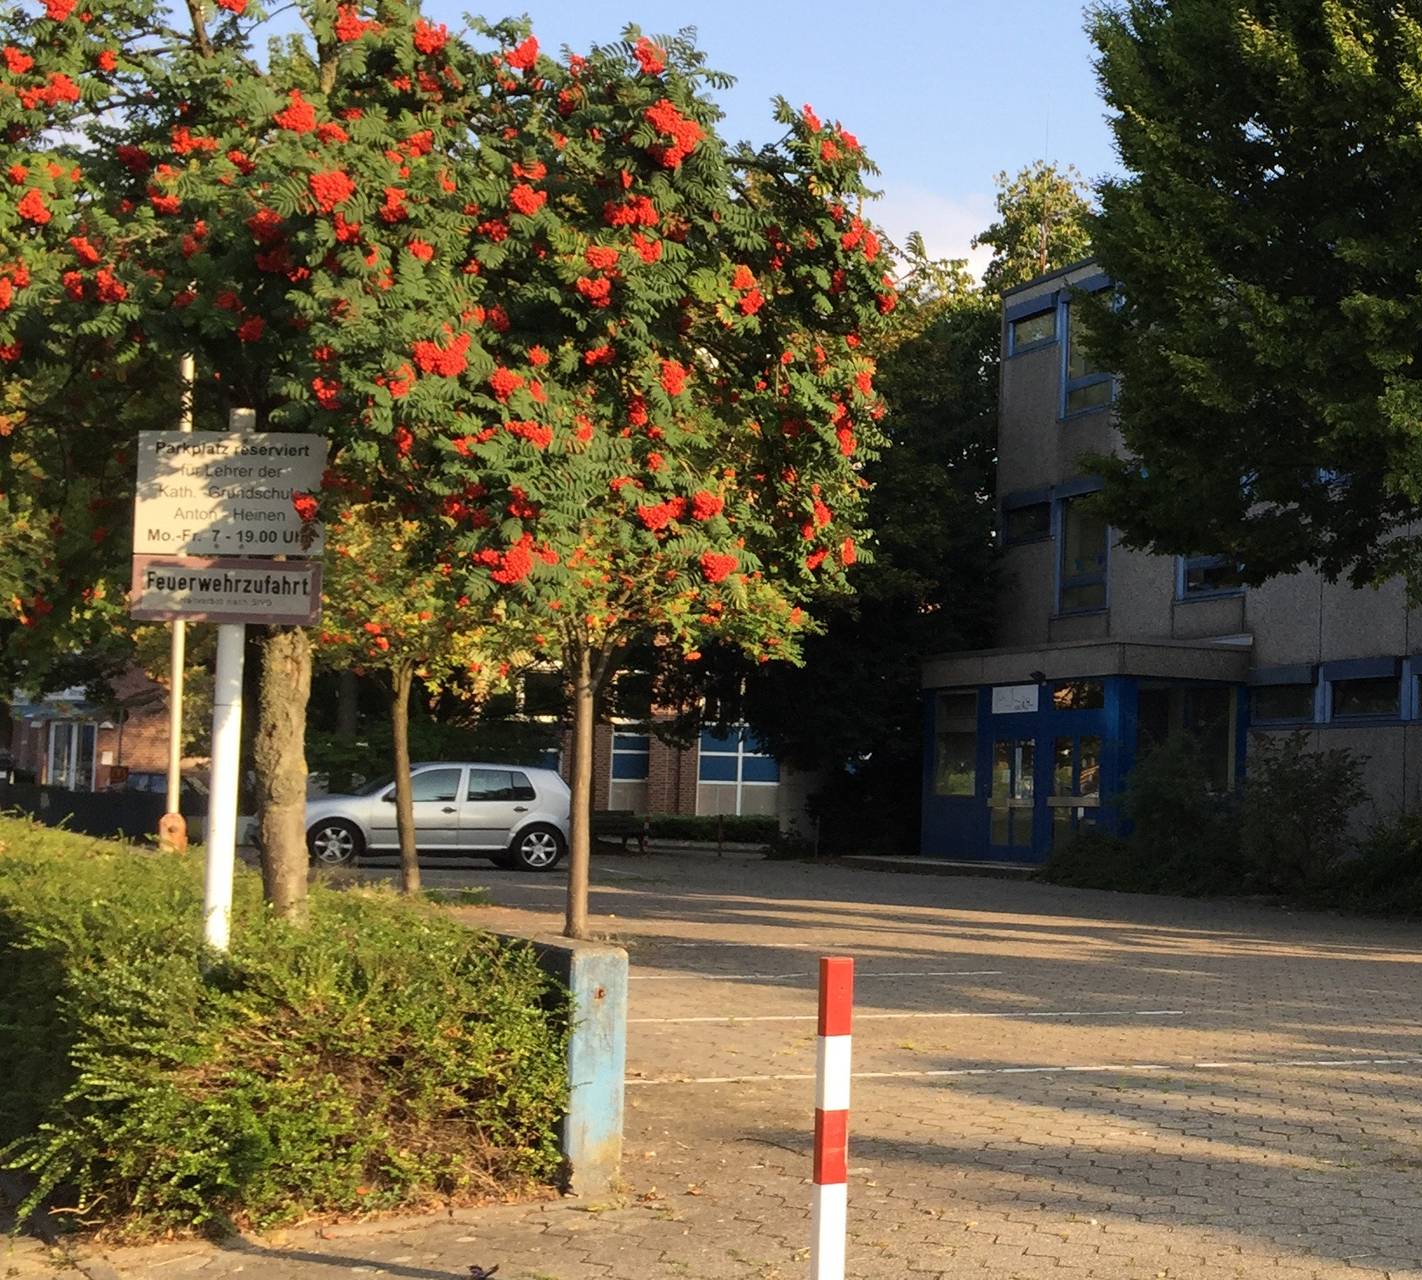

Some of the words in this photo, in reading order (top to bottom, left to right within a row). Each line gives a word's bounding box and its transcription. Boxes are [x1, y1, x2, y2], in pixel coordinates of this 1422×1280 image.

[155, 441, 229, 457] Parkplatz
[234, 443, 310, 457] reserviert
[181, 464, 201, 476] für
[205, 465, 253, 477] Lehrer
[258, 466, 282, 478] der
[158, 485, 197, 498] Kath.
[207, 485, 303, 500] Grundschul
[173, 507, 218, 521] Anton
[233, 508, 286, 522] Heinen
[211, 529, 220, 542] 7
[236, 530, 278, 544] 19.00
[146, 571, 310, 596] Feuerwehrzufahrt
